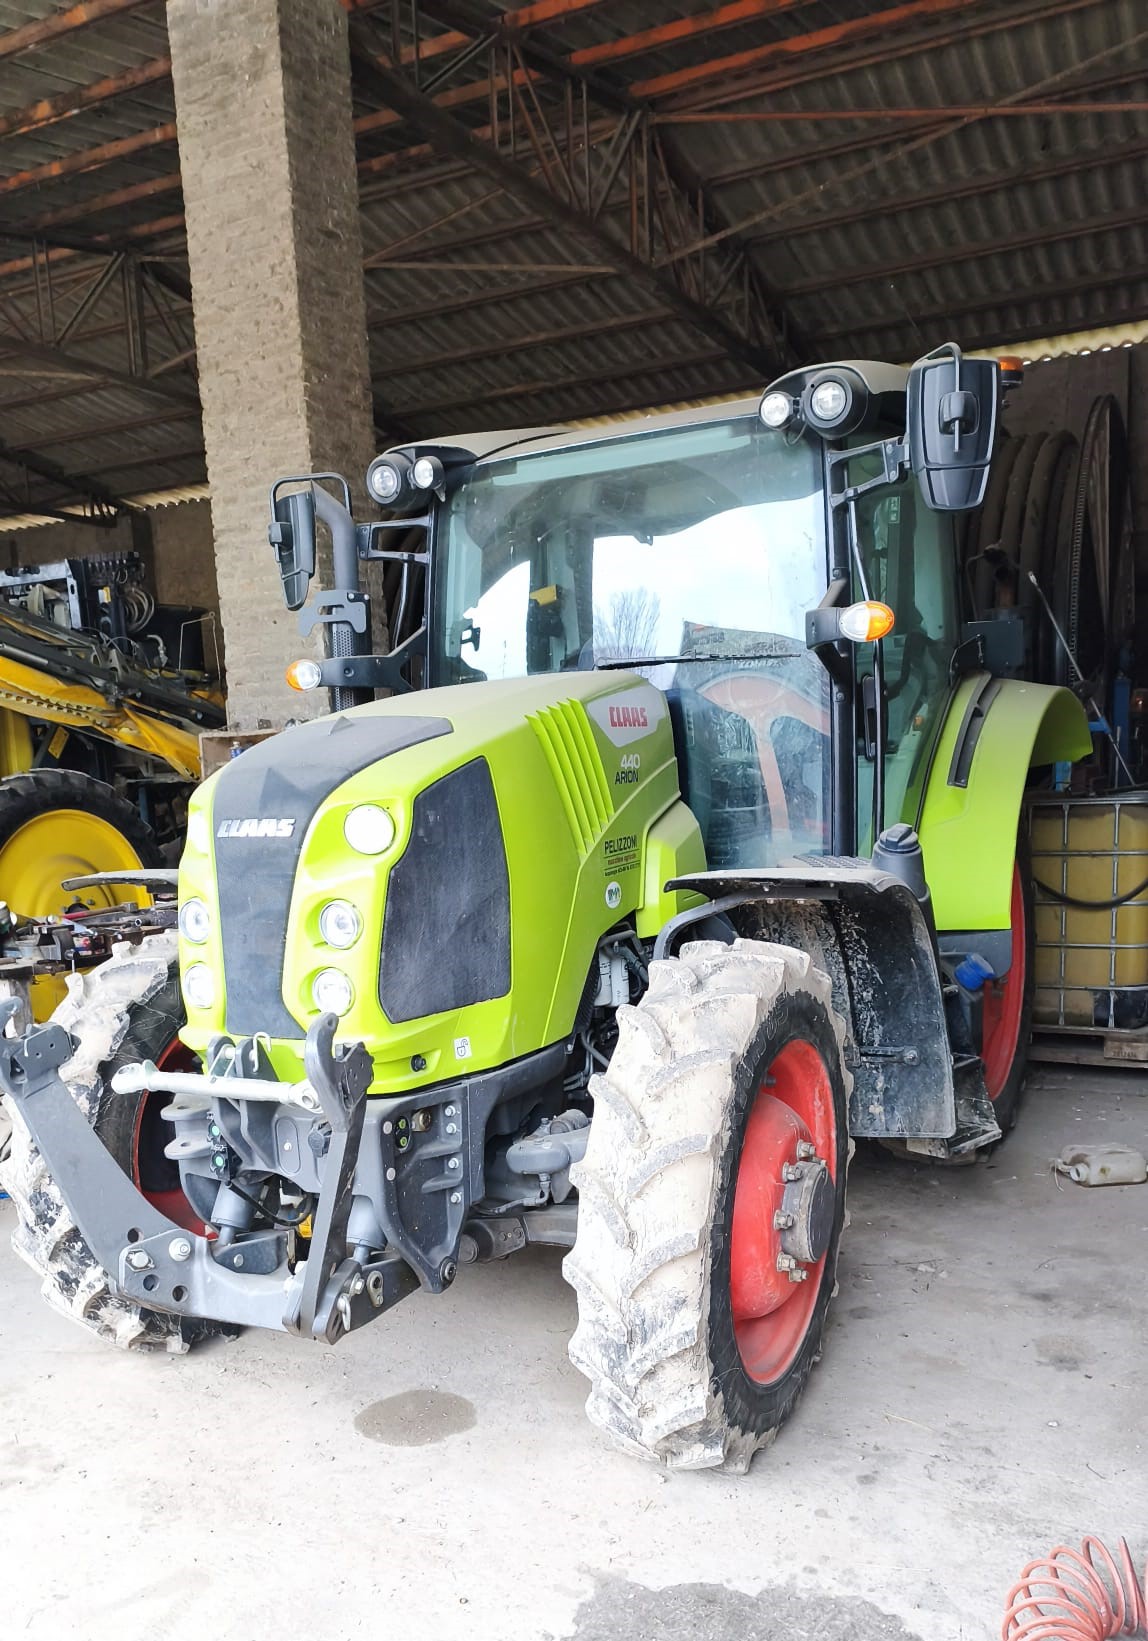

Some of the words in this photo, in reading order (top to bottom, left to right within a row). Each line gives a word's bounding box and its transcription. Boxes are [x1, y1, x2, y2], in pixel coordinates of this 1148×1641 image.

[608, 706, 648, 728] CLAAS
[620, 753, 640, 769] 440
[615, 770, 638, 785] ARION
[216, 818, 296, 838] CLAAS
[604, 834, 638, 855] PELIZZONI
